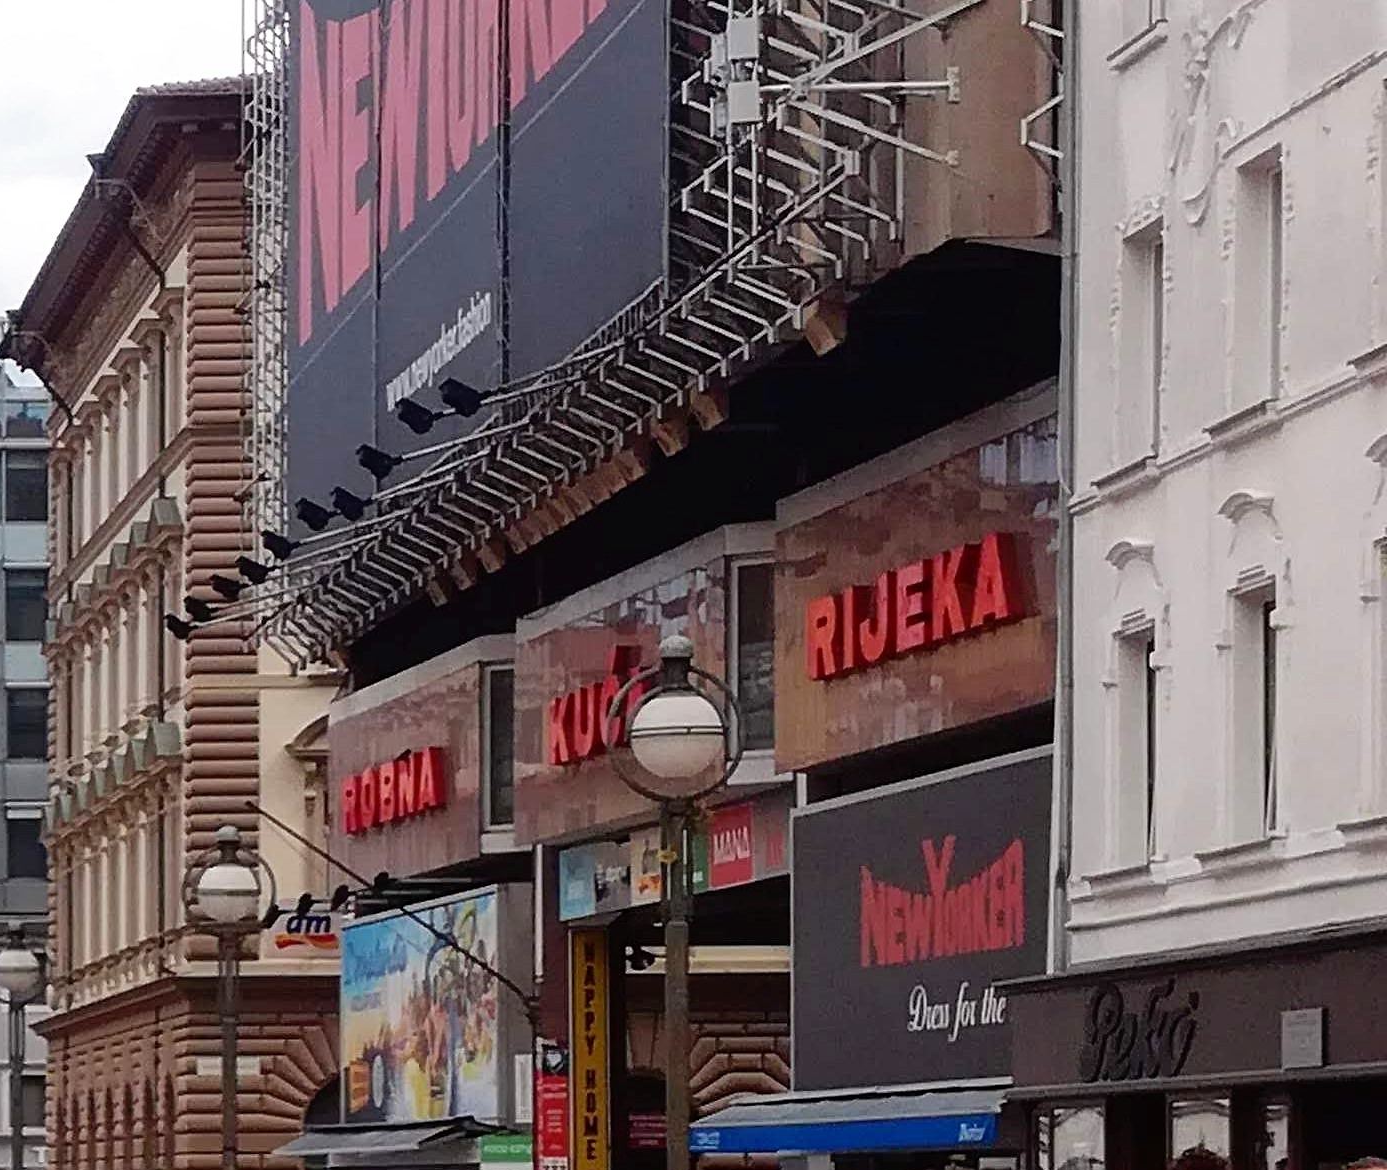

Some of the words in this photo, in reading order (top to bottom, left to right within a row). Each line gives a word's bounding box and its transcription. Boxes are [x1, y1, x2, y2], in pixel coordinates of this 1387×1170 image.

[805, 531, 1010, 681] RIJEKA
[341, 746, 443, 834] ROBNA
[287, 912, 332, 934] dm
[907, 985, 949, 1031] Dress
[947, 981, 979, 1041] for
[981, 986, 1007, 1025] the
[583, 1068, 598, 1161] HOME
